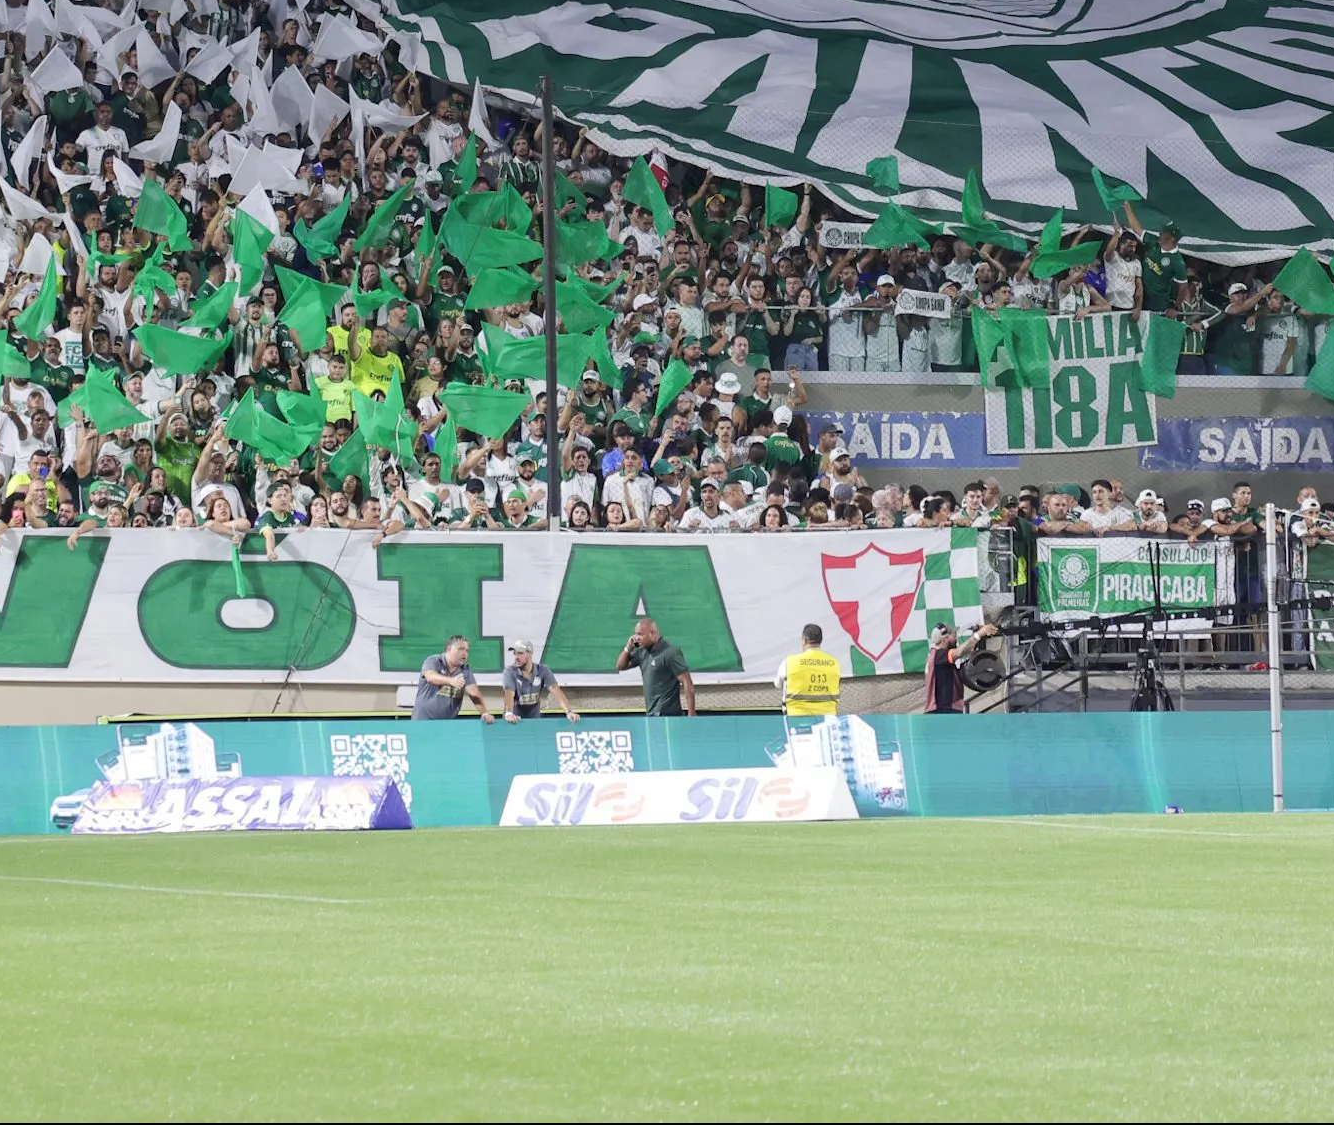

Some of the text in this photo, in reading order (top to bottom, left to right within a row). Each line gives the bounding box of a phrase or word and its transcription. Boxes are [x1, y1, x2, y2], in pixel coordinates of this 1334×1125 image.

[851, 412, 956, 461] AÍDA
[1198, 418, 1333, 466] SAÍDA
[1138, 547, 1208, 563] COSULADO
[1103, 574, 1208, 603] PIRACCABA
[810, 674, 827, 684] 013
